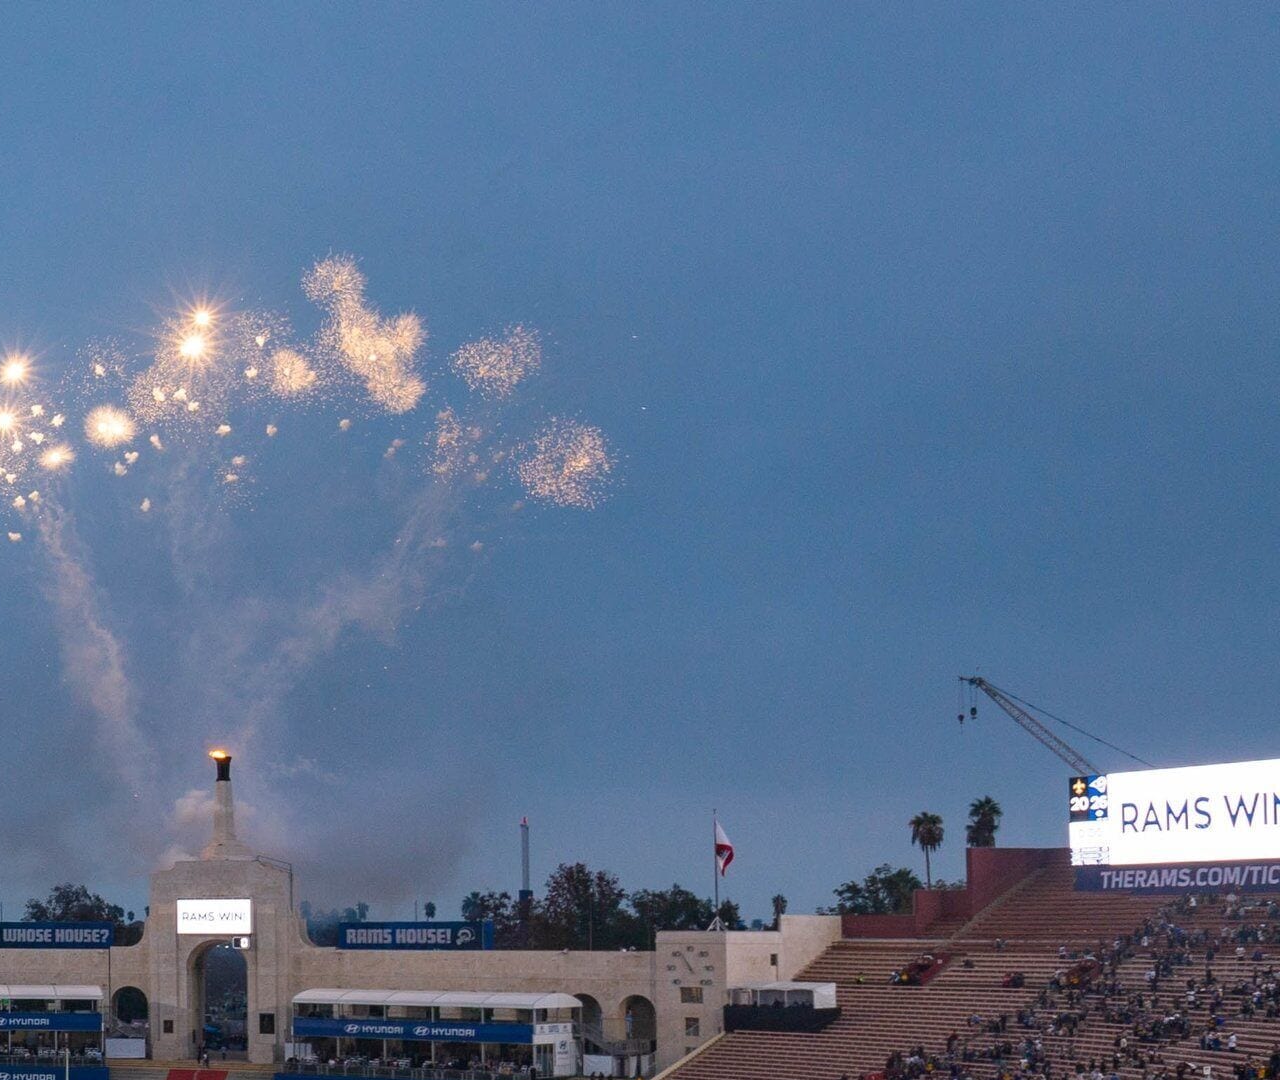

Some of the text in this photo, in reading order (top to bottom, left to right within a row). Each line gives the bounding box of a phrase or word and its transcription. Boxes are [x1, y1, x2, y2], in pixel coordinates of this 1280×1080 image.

[1070, 797, 1089, 812] 20
[1121, 797, 1212, 833] RAMS
[182, 912, 215, 921] RAMS
[2, 928, 110, 942] WHOSE HOUSE?
[346, 929, 451, 944] RAMS HOUSE!
[431, 1028, 475, 1036] HYUNDAI
